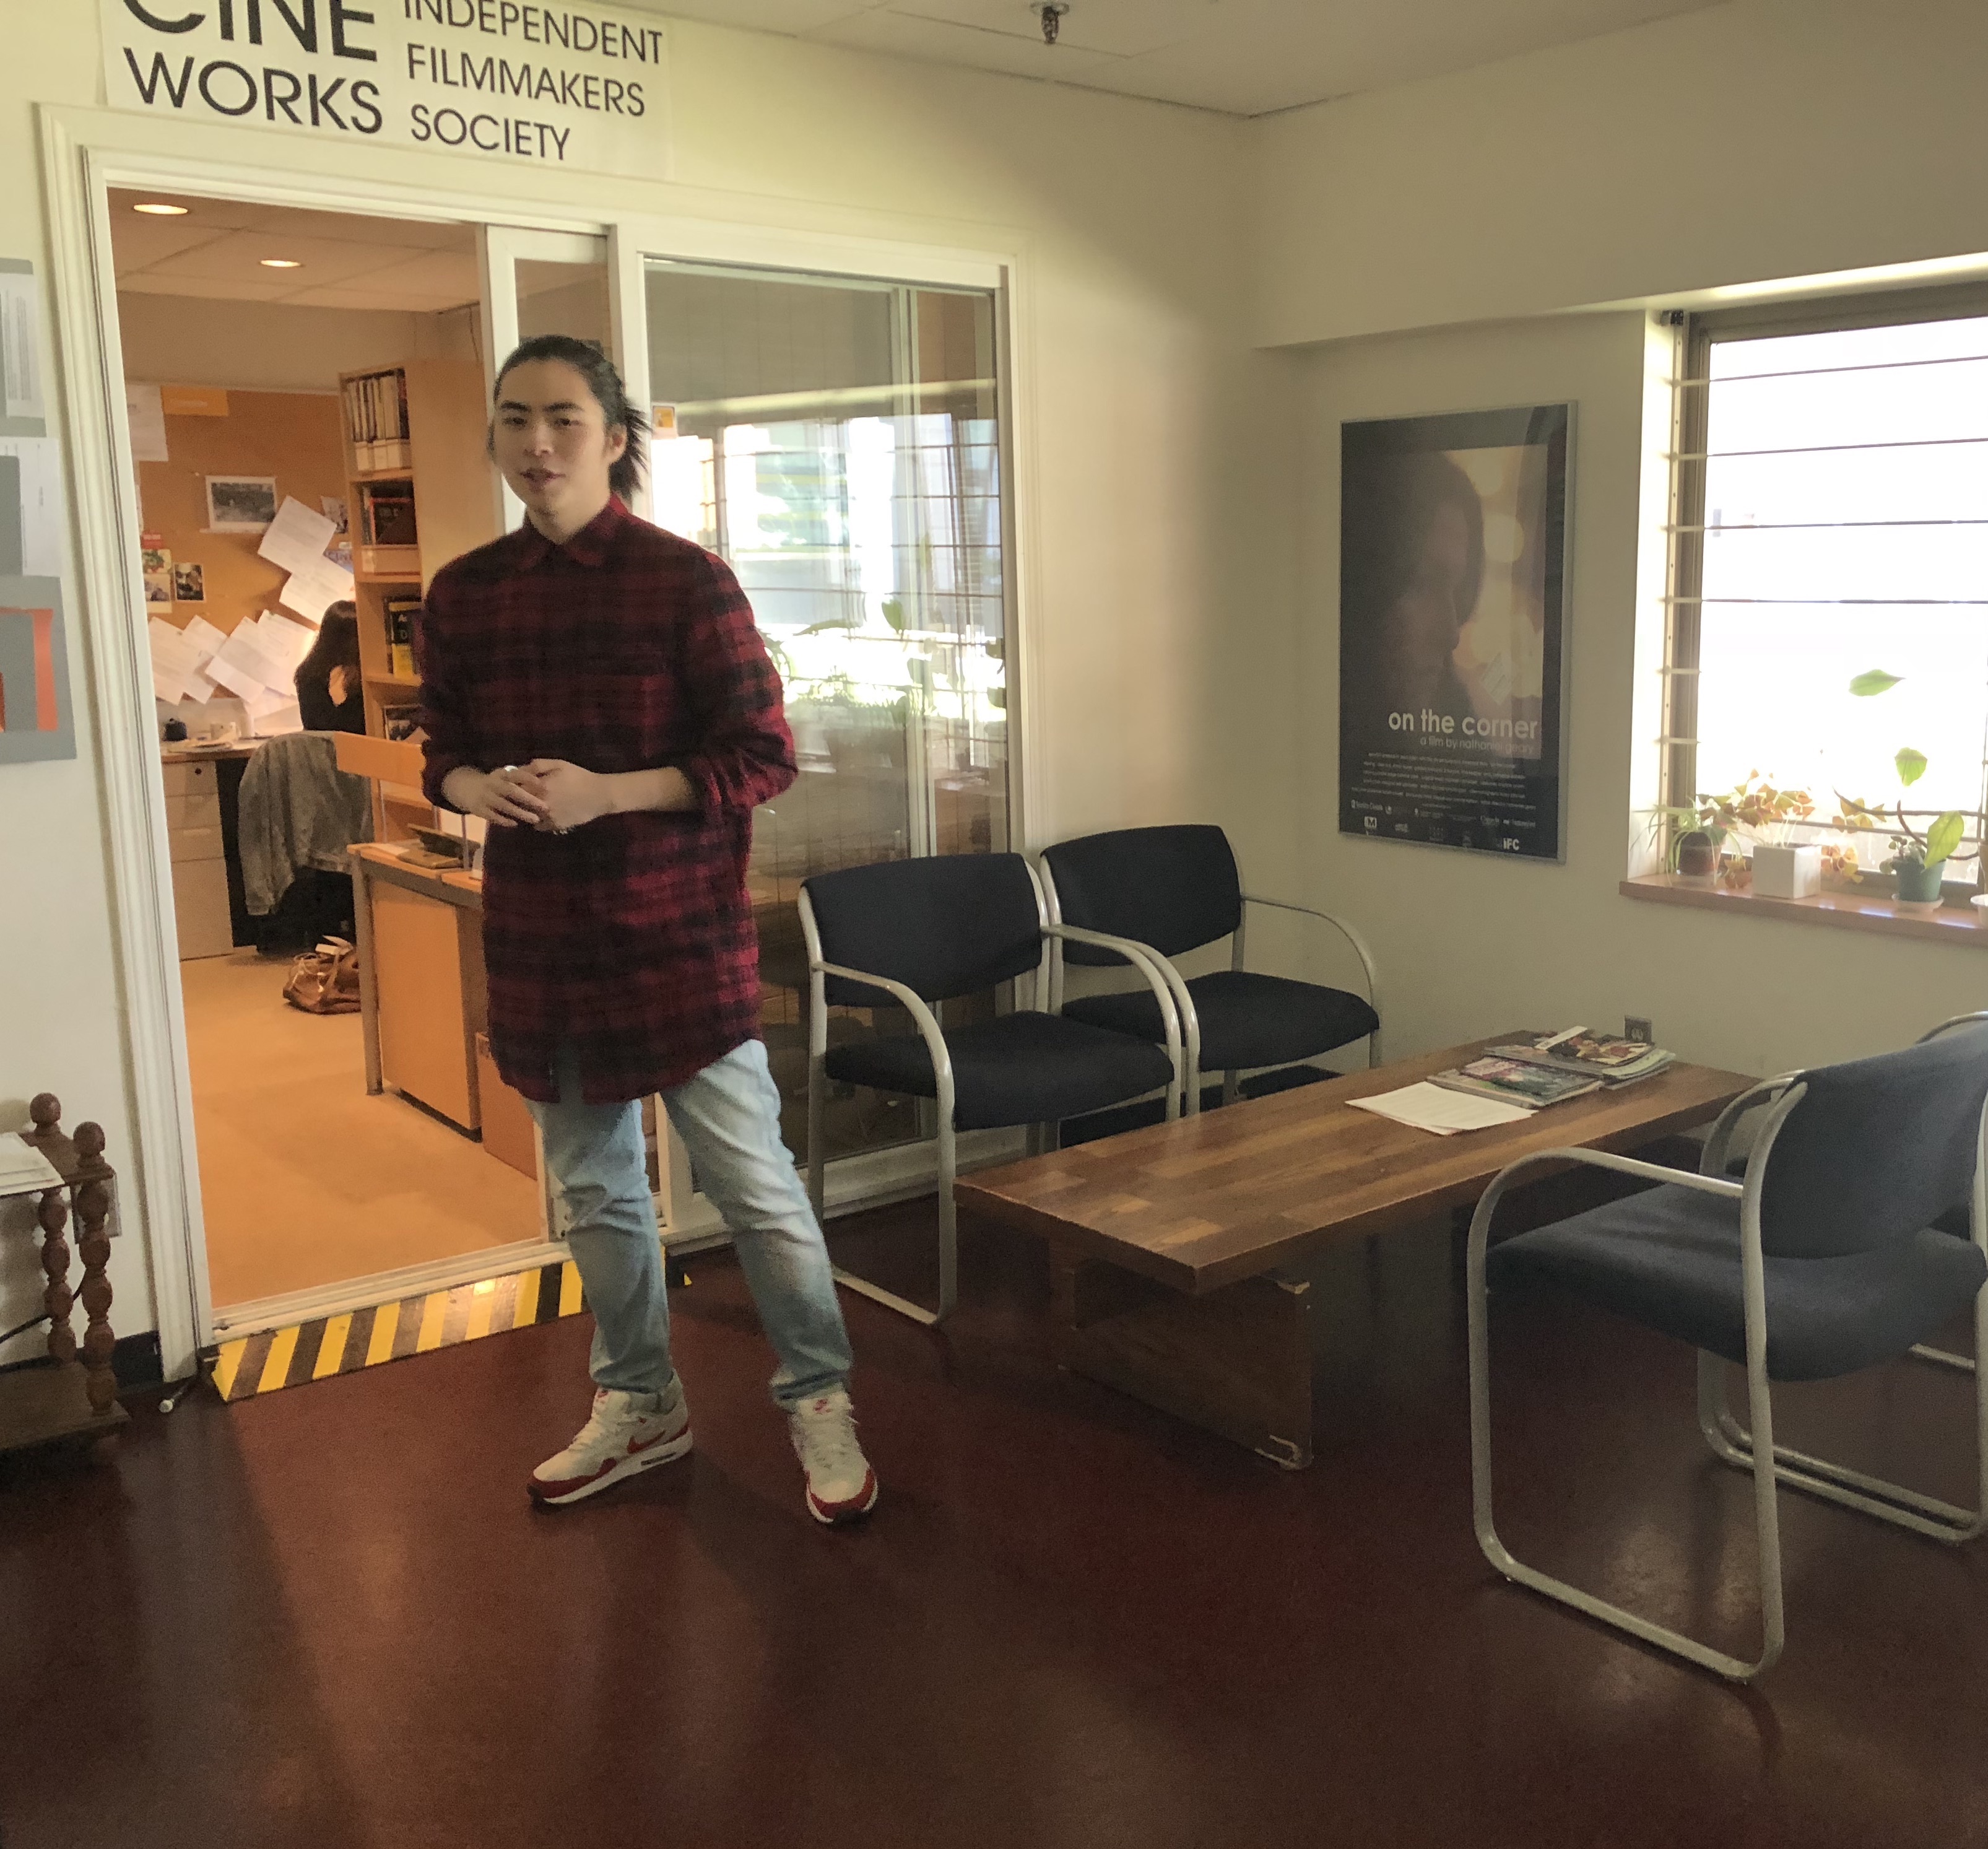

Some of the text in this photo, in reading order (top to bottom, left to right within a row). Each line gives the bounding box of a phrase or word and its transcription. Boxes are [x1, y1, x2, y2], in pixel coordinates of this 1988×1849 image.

[404, 0, 662, 64] INDEPENDENT
[123, 46, 383, 134] WORKS
[407, 42, 645, 116] FILMMAKERS
[410, 103, 570, 160] SOCIETY
[1388, 708, 1538, 739] on the corner
[1420, 737, 1427, 745] a
[1428, 736, 1444, 747] film
[1446, 737, 1457, 749] by
